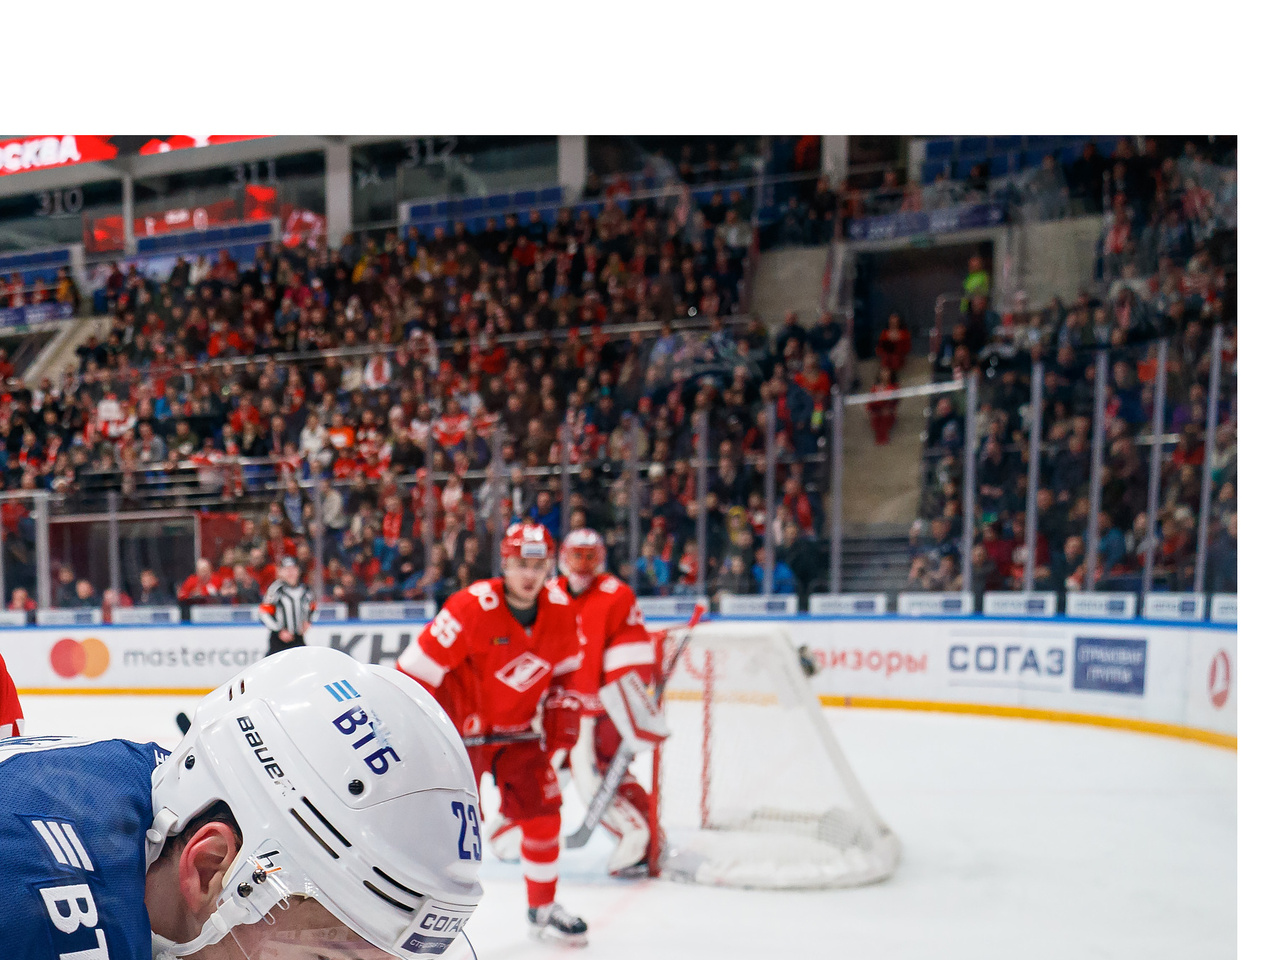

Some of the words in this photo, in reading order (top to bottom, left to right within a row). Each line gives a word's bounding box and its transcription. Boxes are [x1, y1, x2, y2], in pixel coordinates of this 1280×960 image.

[122, 644, 262, 668] mastercar
[949, 644, 1065, 677] СОГАЗ
[332, 705, 402, 775] ВТБ
[451, 800, 482, 861] 23
